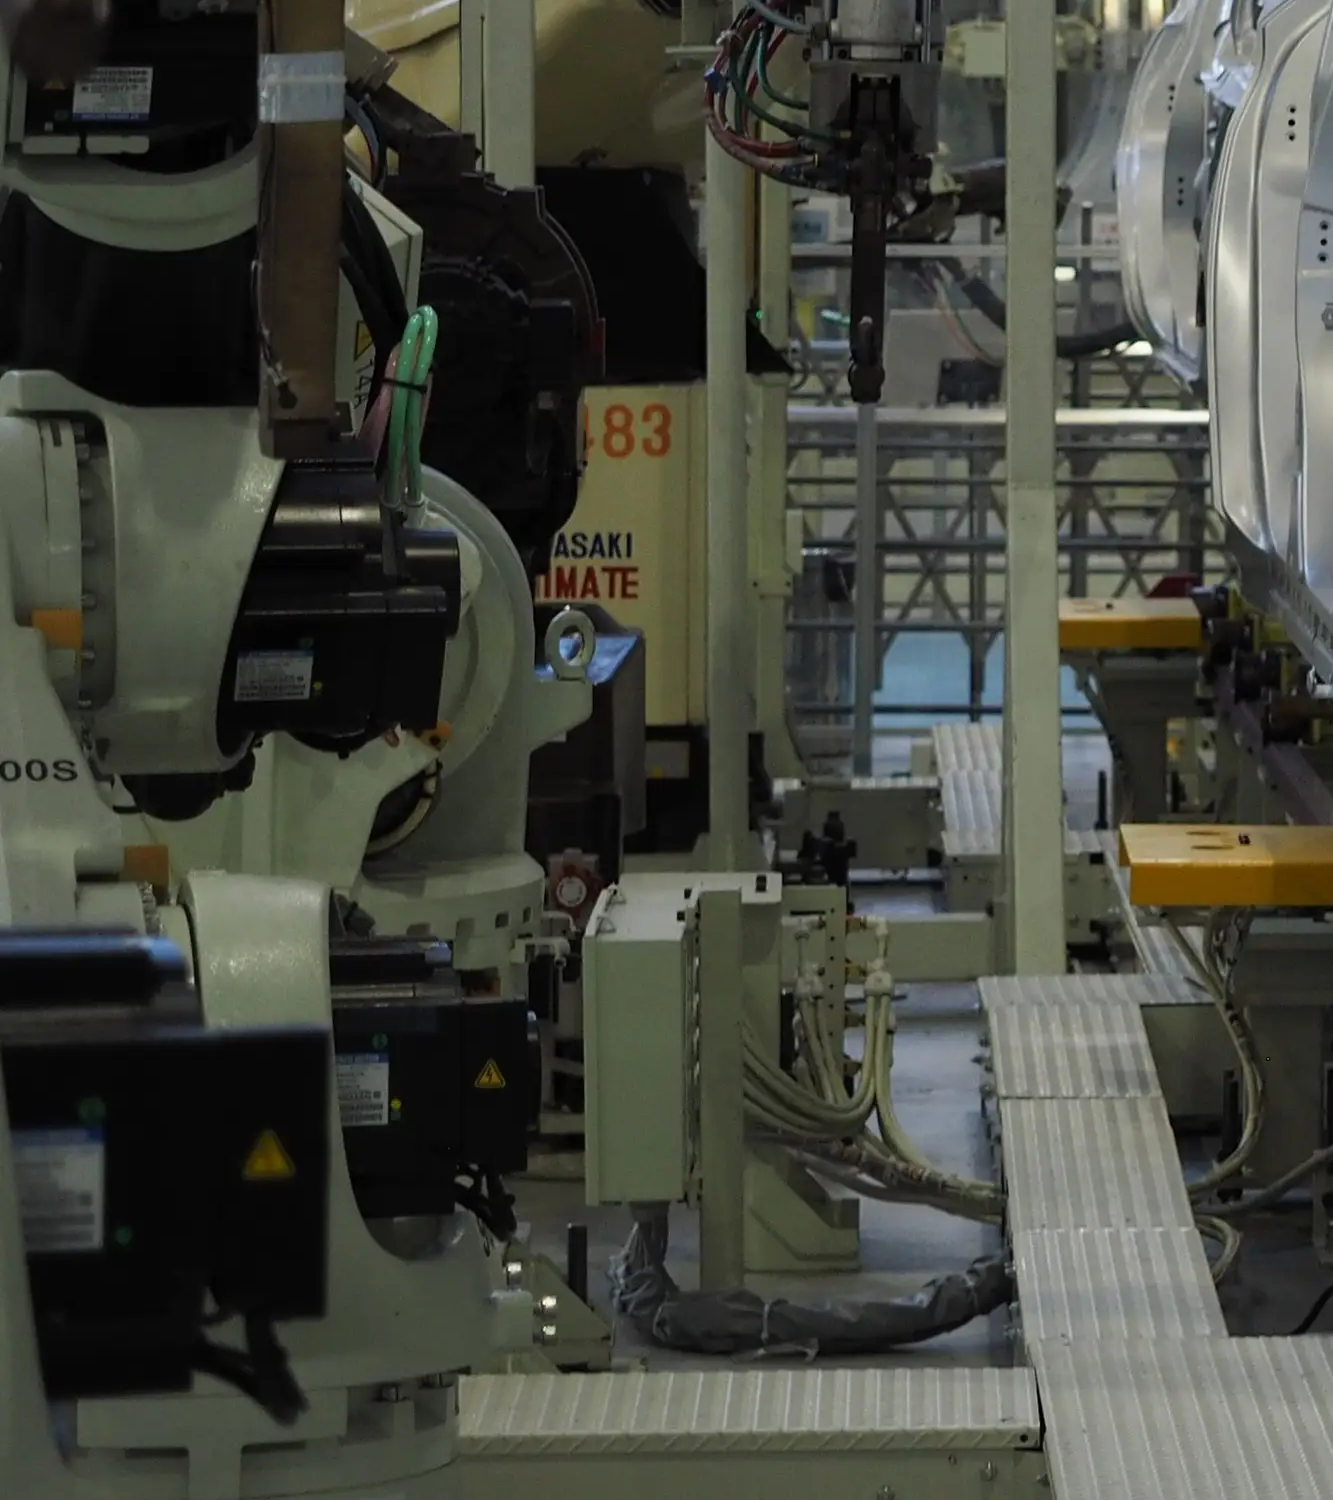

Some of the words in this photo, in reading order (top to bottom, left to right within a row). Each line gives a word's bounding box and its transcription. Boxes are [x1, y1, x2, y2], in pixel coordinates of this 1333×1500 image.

[584, 404, 672, 458] 83
[555, 532, 632, 558] ASAKI
[544, 566, 638, 599] IMATE
